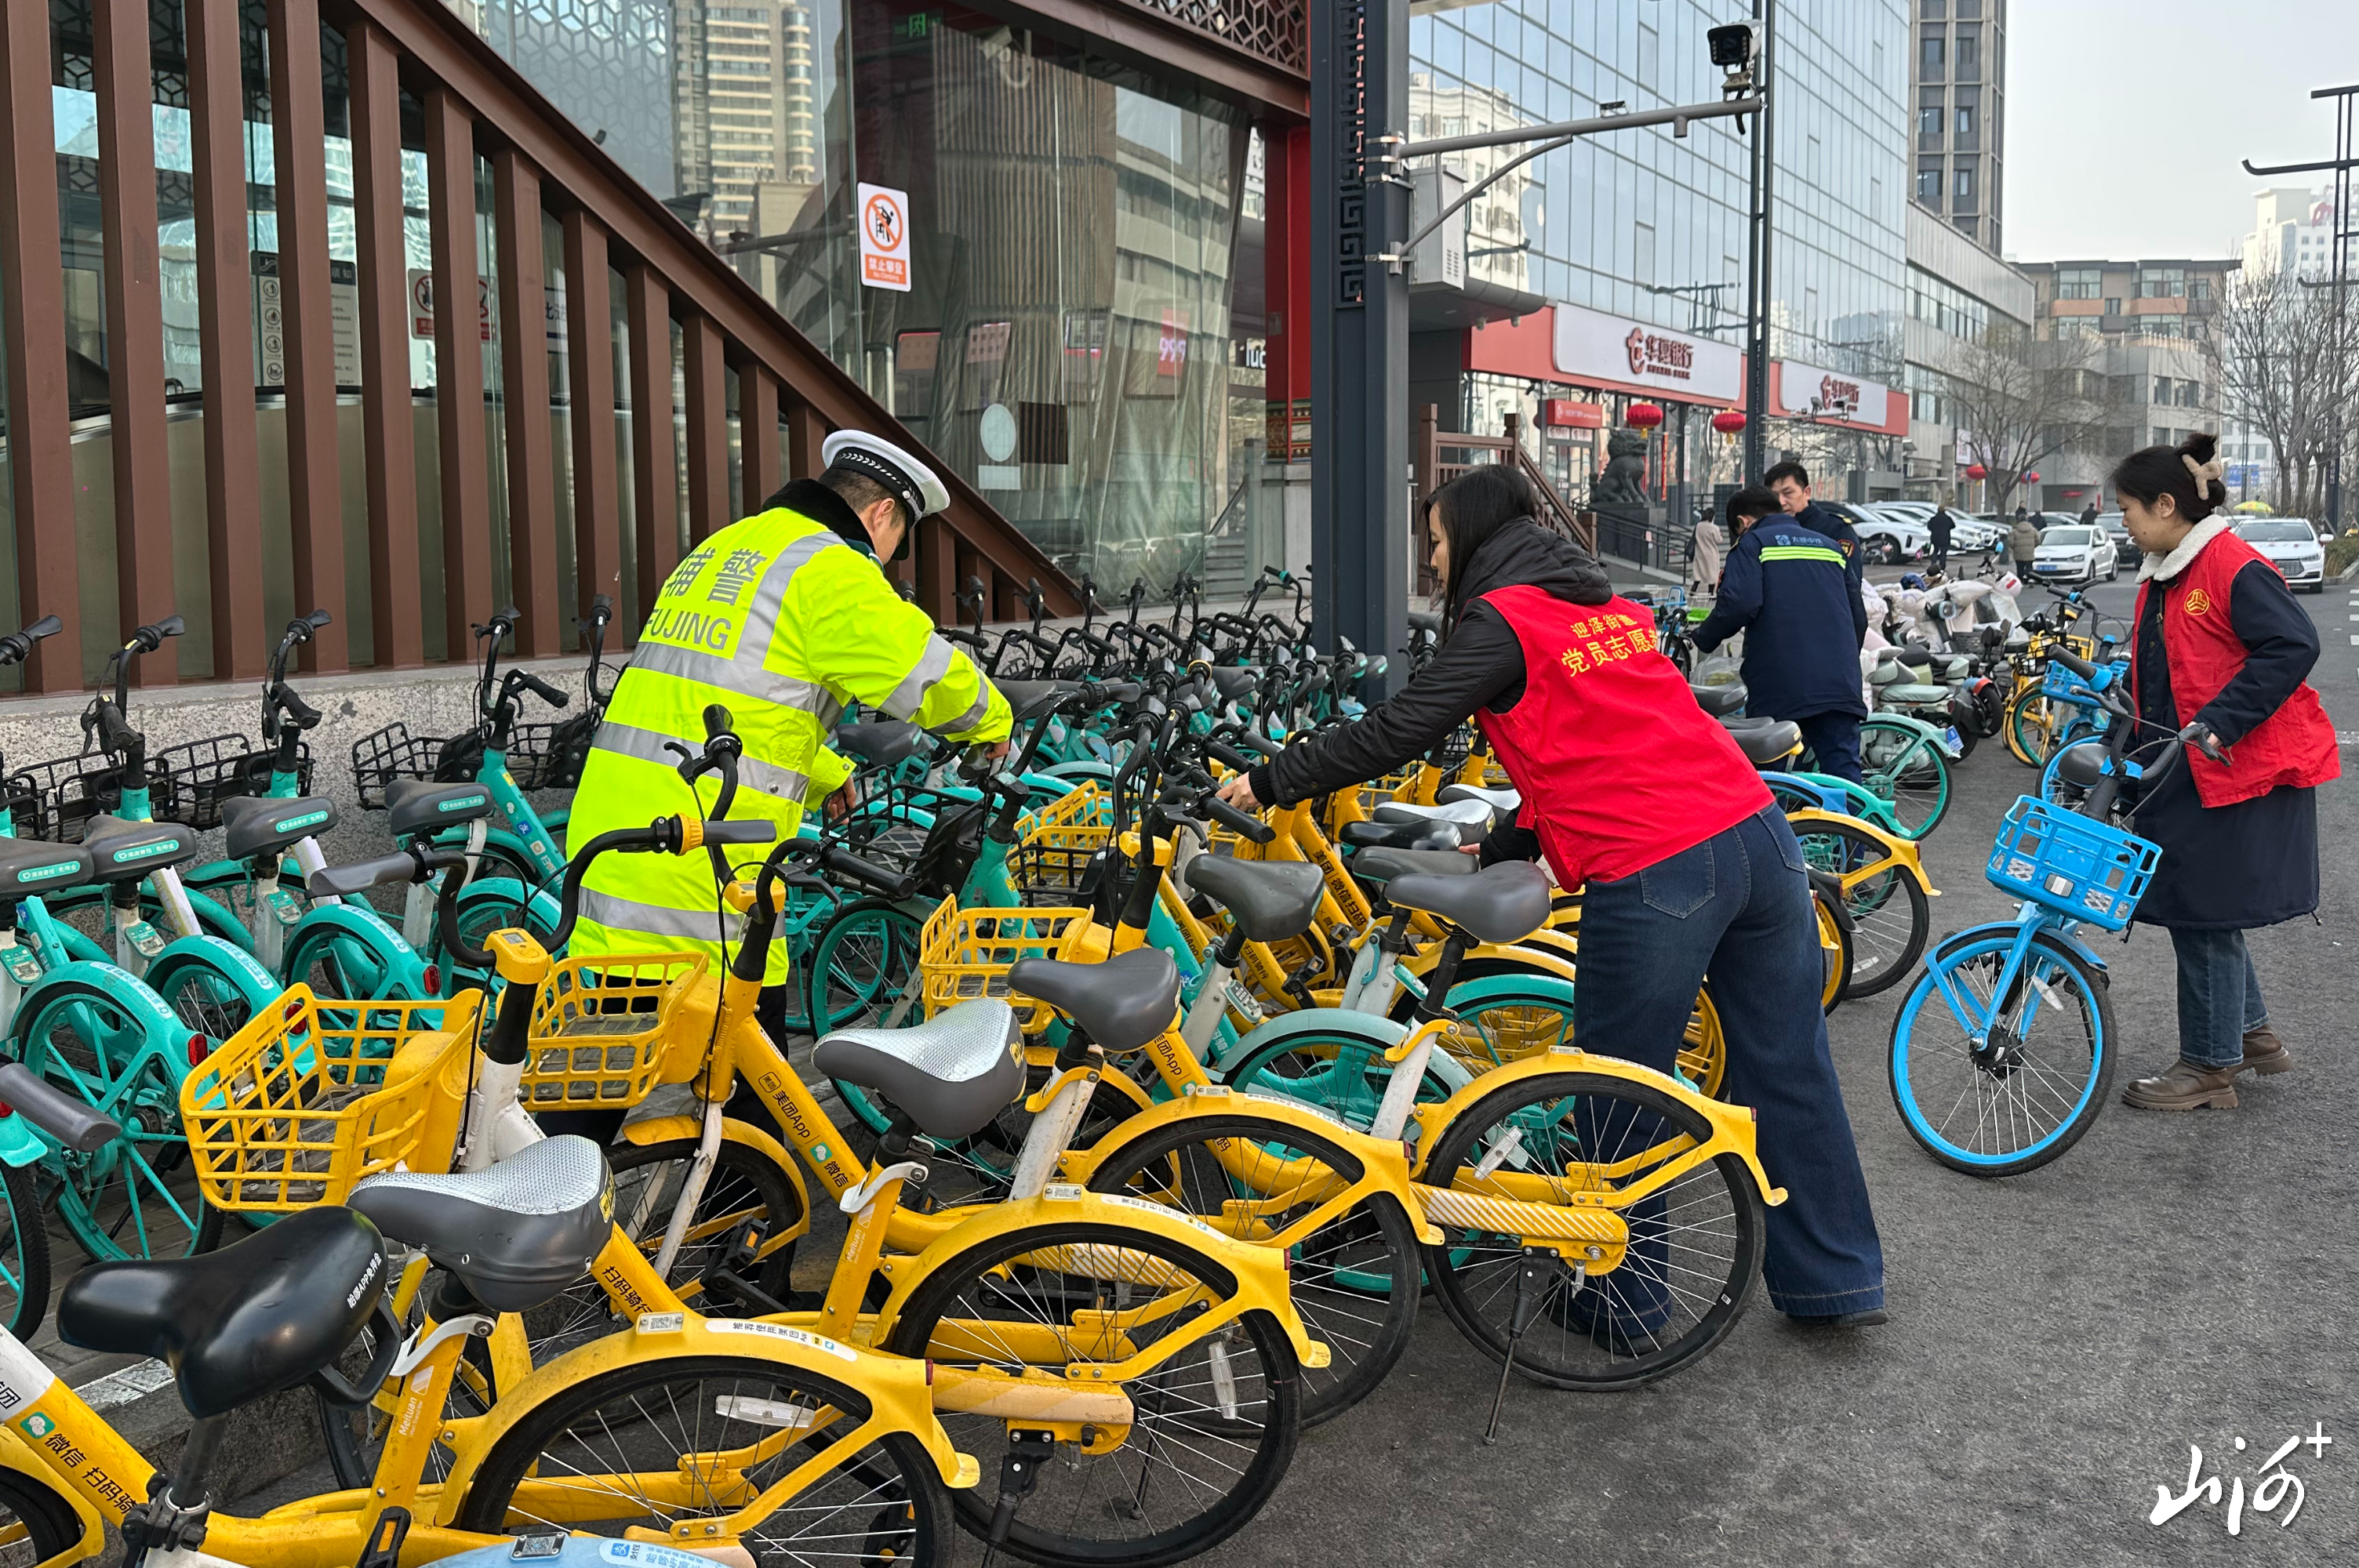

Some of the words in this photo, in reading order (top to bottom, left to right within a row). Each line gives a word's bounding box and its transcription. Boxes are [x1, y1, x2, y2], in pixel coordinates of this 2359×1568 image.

[868, 256, 903, 275] 禁止攀登
[1645, 335, 1694, 369] 华夏银行
[772, 1090, 811, 1138] 美团App
[823, 1160, 849, 1188] 微信
[602, 1265, 652, 1314] 扫码骑行
[398, 1396, 418, 1436] Meituan
[45, 1433, 87, 1468] 微信
